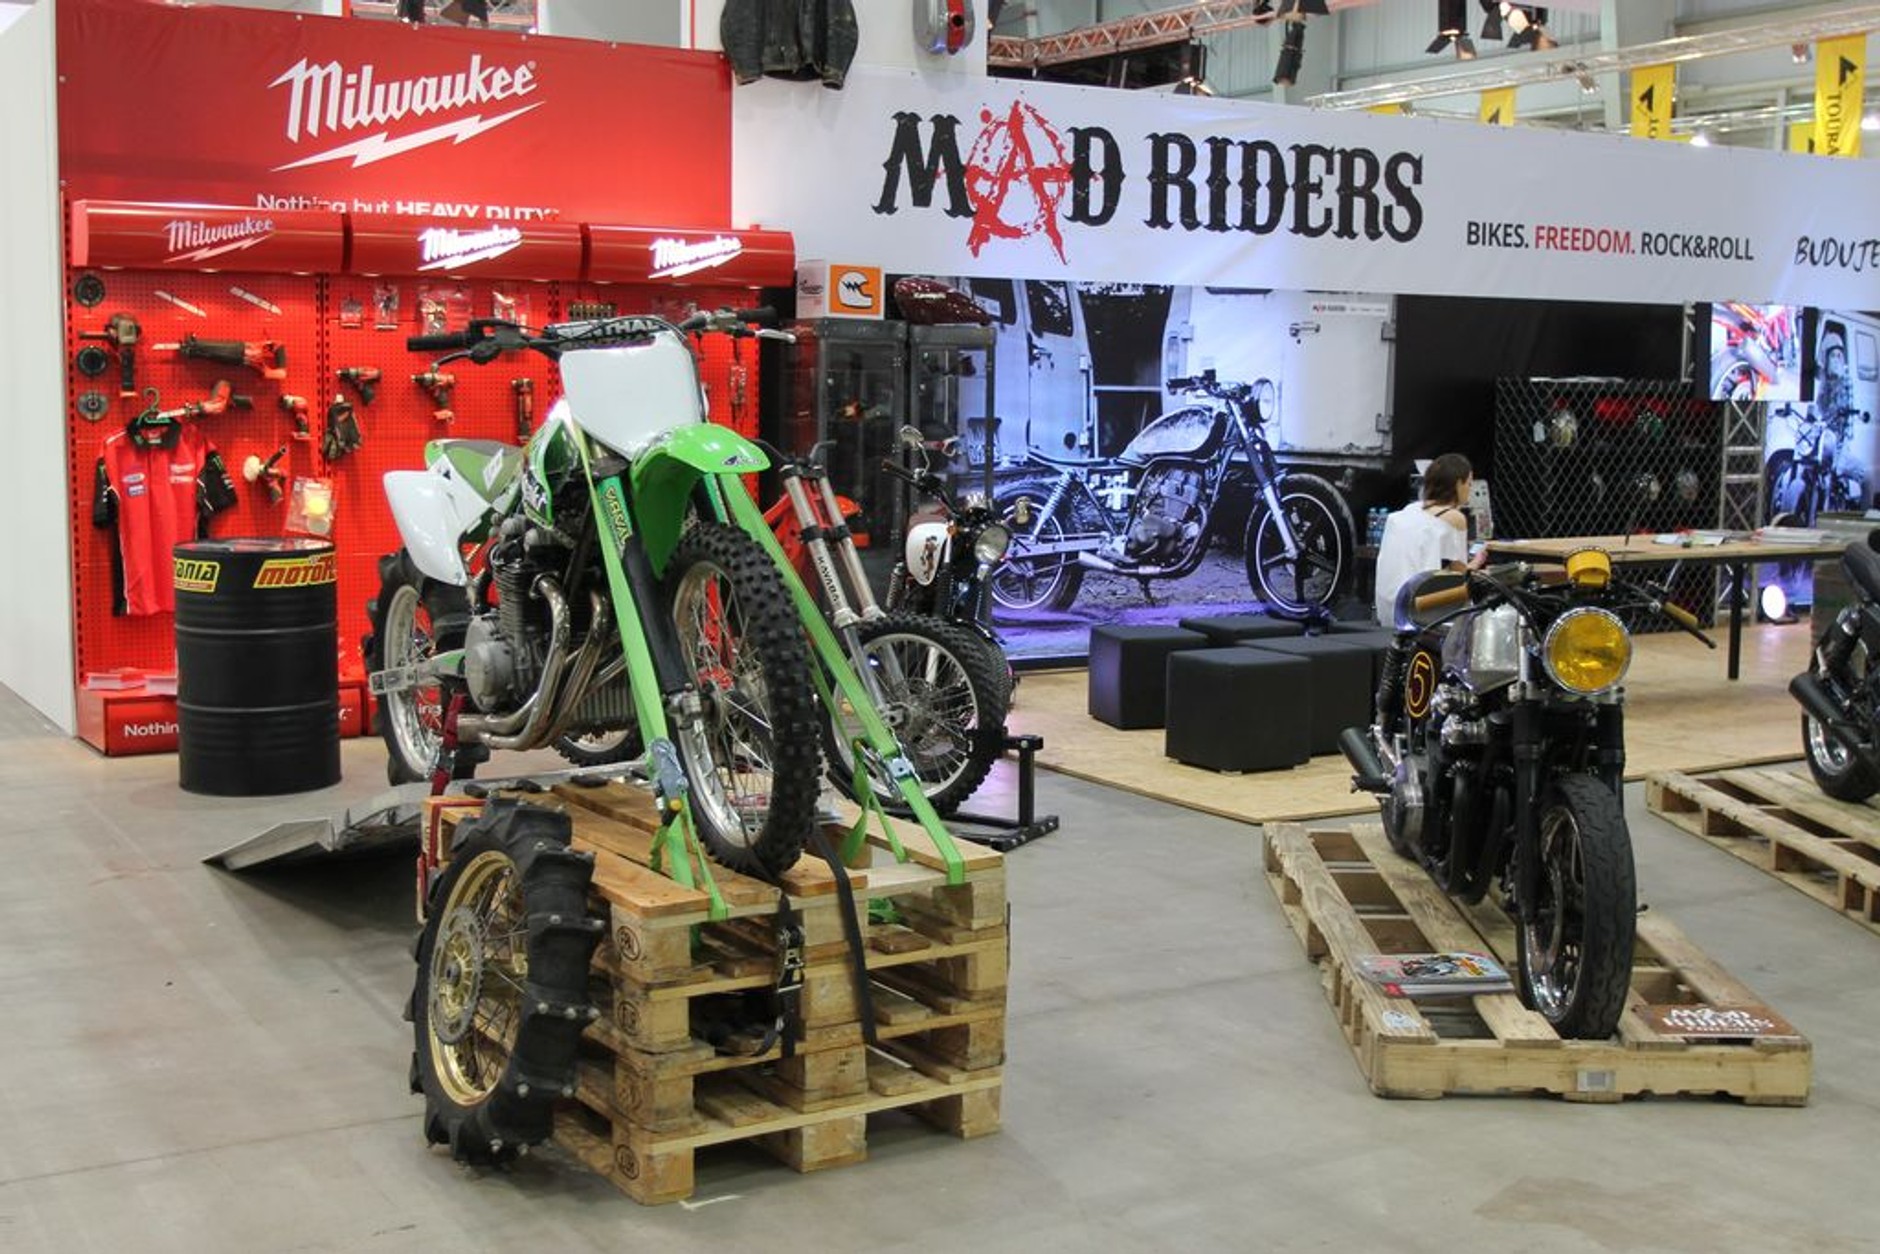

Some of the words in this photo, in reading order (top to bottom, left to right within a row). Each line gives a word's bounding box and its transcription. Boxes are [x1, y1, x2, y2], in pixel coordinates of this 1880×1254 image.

[871, 100, 1126, 265] MAD
[1144, 131, 1423, 243] RIDERS
[163, 217, 274, 253] Milwaukee
[1466, 221, 1529, 249] BIKES.
[1534, 225, 1636, 255] FREEDOM.
[1641, 232, 1754, 261] ROCK&ROLL
[1411, 657, 1430, 708] 5
